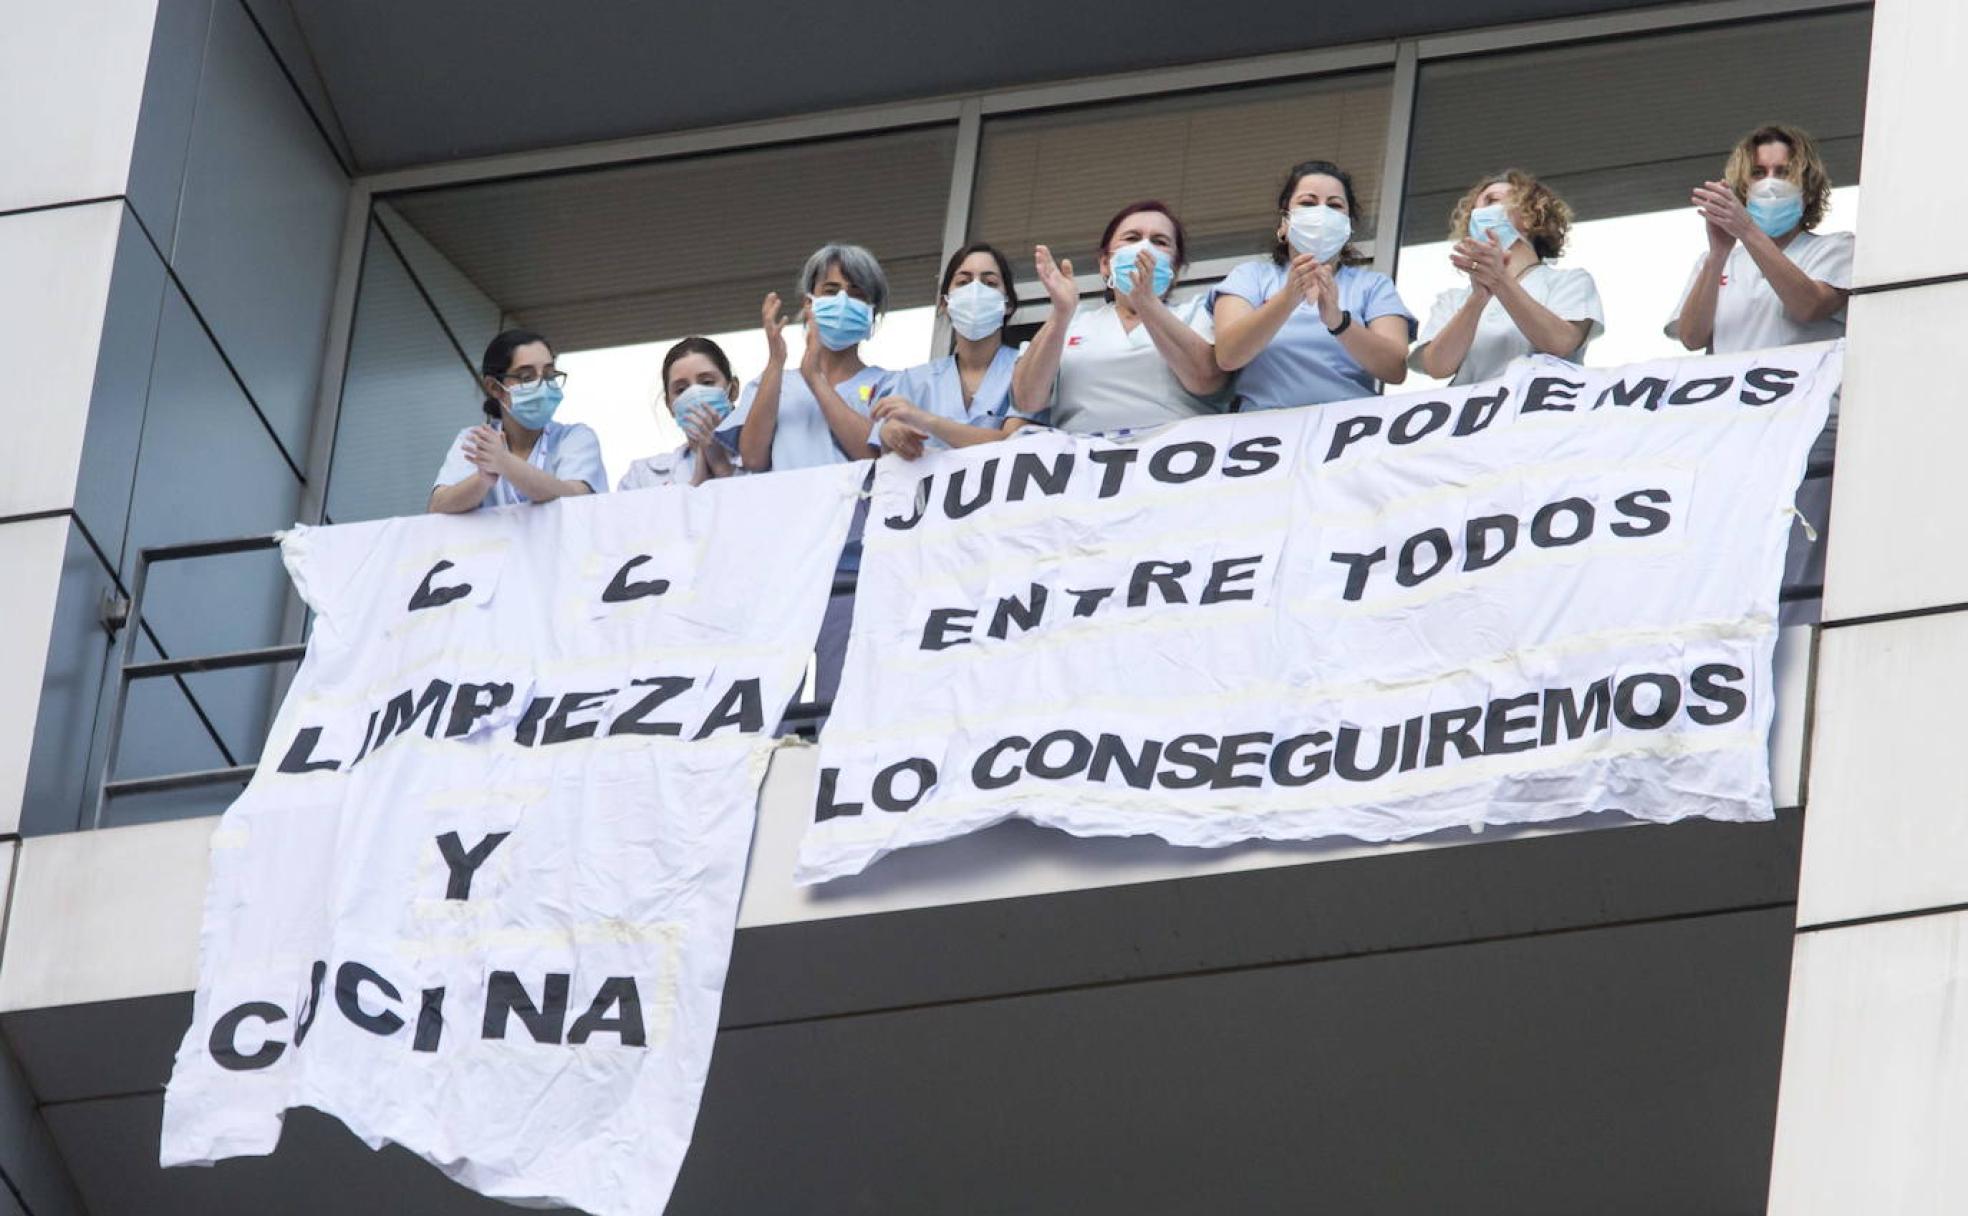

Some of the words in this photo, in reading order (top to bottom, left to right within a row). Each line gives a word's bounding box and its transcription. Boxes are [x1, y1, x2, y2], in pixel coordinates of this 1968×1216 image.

[884, 436, 1282, 531] JUNTOS
[1324, 367, 1799, 463] PODEMOS
[919, 555, 1263, 651] ENTRE
[1330, 489, 1671, 601] TODOS
[277, 675, 764, 774] LIMPIEZA
[814, 757, 938, 823] LO
[971, 663, 1747, 790] CONSEGUIREMOS
[435, 831, 511, 901] Y
